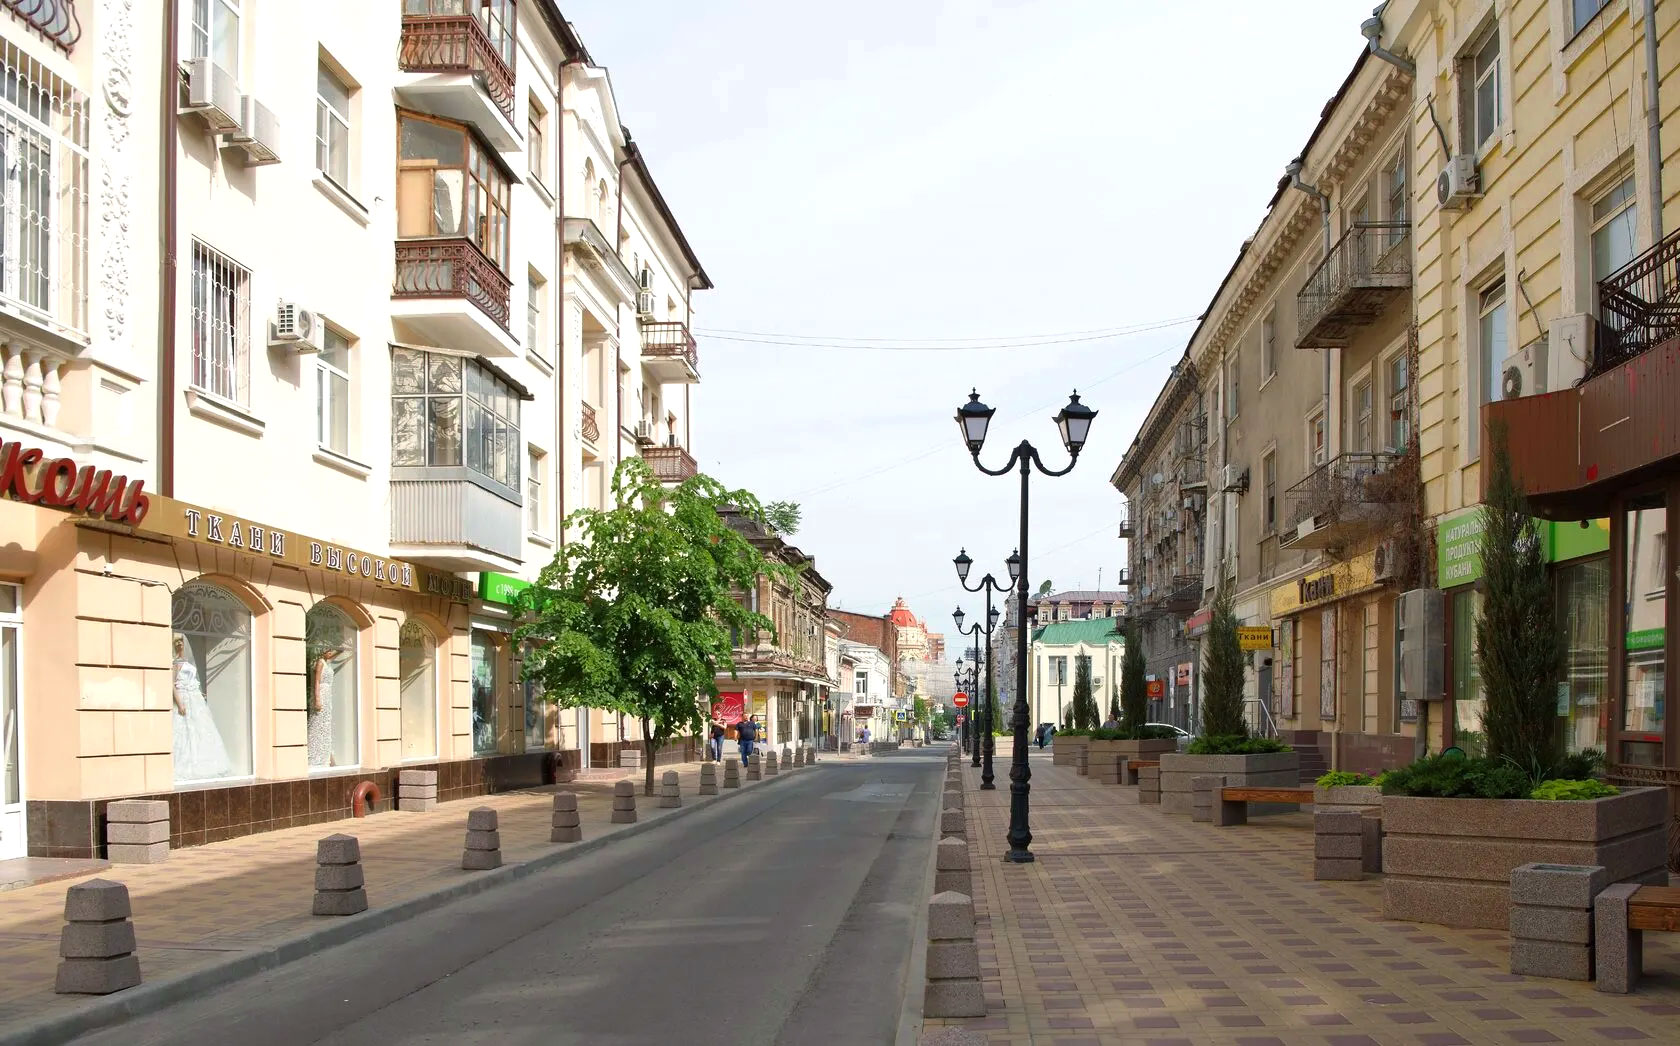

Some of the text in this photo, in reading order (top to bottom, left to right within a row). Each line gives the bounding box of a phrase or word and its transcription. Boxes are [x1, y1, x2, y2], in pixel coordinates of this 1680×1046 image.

[0, 436, 149, 529] коть
[185, 508, 286, 557] ТКАНИ
[310, 541, 412, 587] ВЫСОКОЙ
[1445, 560, 1472, 580] КУБАНИ
[1297, 573, 1335, 604] Ткани
[1239, 632, 1269, 640] Ткани
